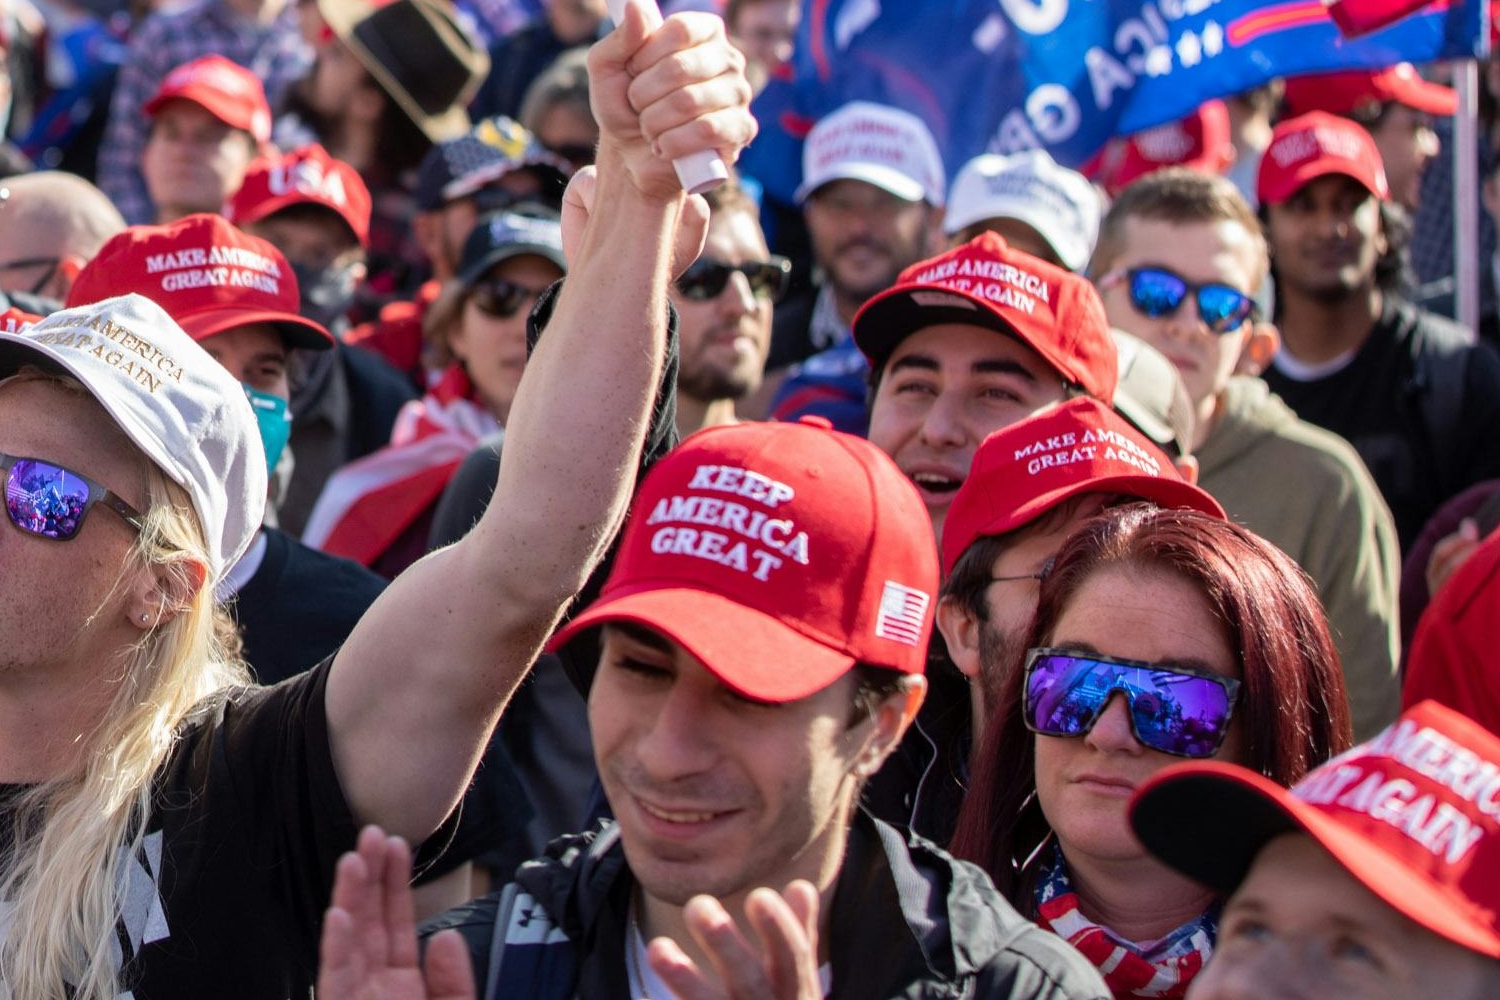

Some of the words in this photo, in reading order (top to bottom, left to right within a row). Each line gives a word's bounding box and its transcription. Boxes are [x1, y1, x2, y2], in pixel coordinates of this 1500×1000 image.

[268, 159, 347, 205] USA
[146, 248, 208, 274] MAKE
[208, 246, 282, 279] AMERICA
[161, 267, 228, 292] GREAT
[229, 269, 279, 296] AGAIN
[957, 259, 1049, 303] AMERICA
[971, 282, 1036, 315] AGAIN
[88, 314, 186, 385] AMERICA
[91, 343, 163, 394] AGAIN
[1014, 432, 1077, 461] MAKE
[1081, 428, 1161, 471] AMERICA
[1027, 446, 1098, 475] GREAT
[1103, 446, 1160, 478] AGAIN
[687, 464, 796, 508] KEEP
[646, 495, 810, 565] AMERICA
[651, 527, 783, 582] GREAT
[1368, 719, 1500, 826] MERIC
[1336, 770, 1485, 866] AGAIN
